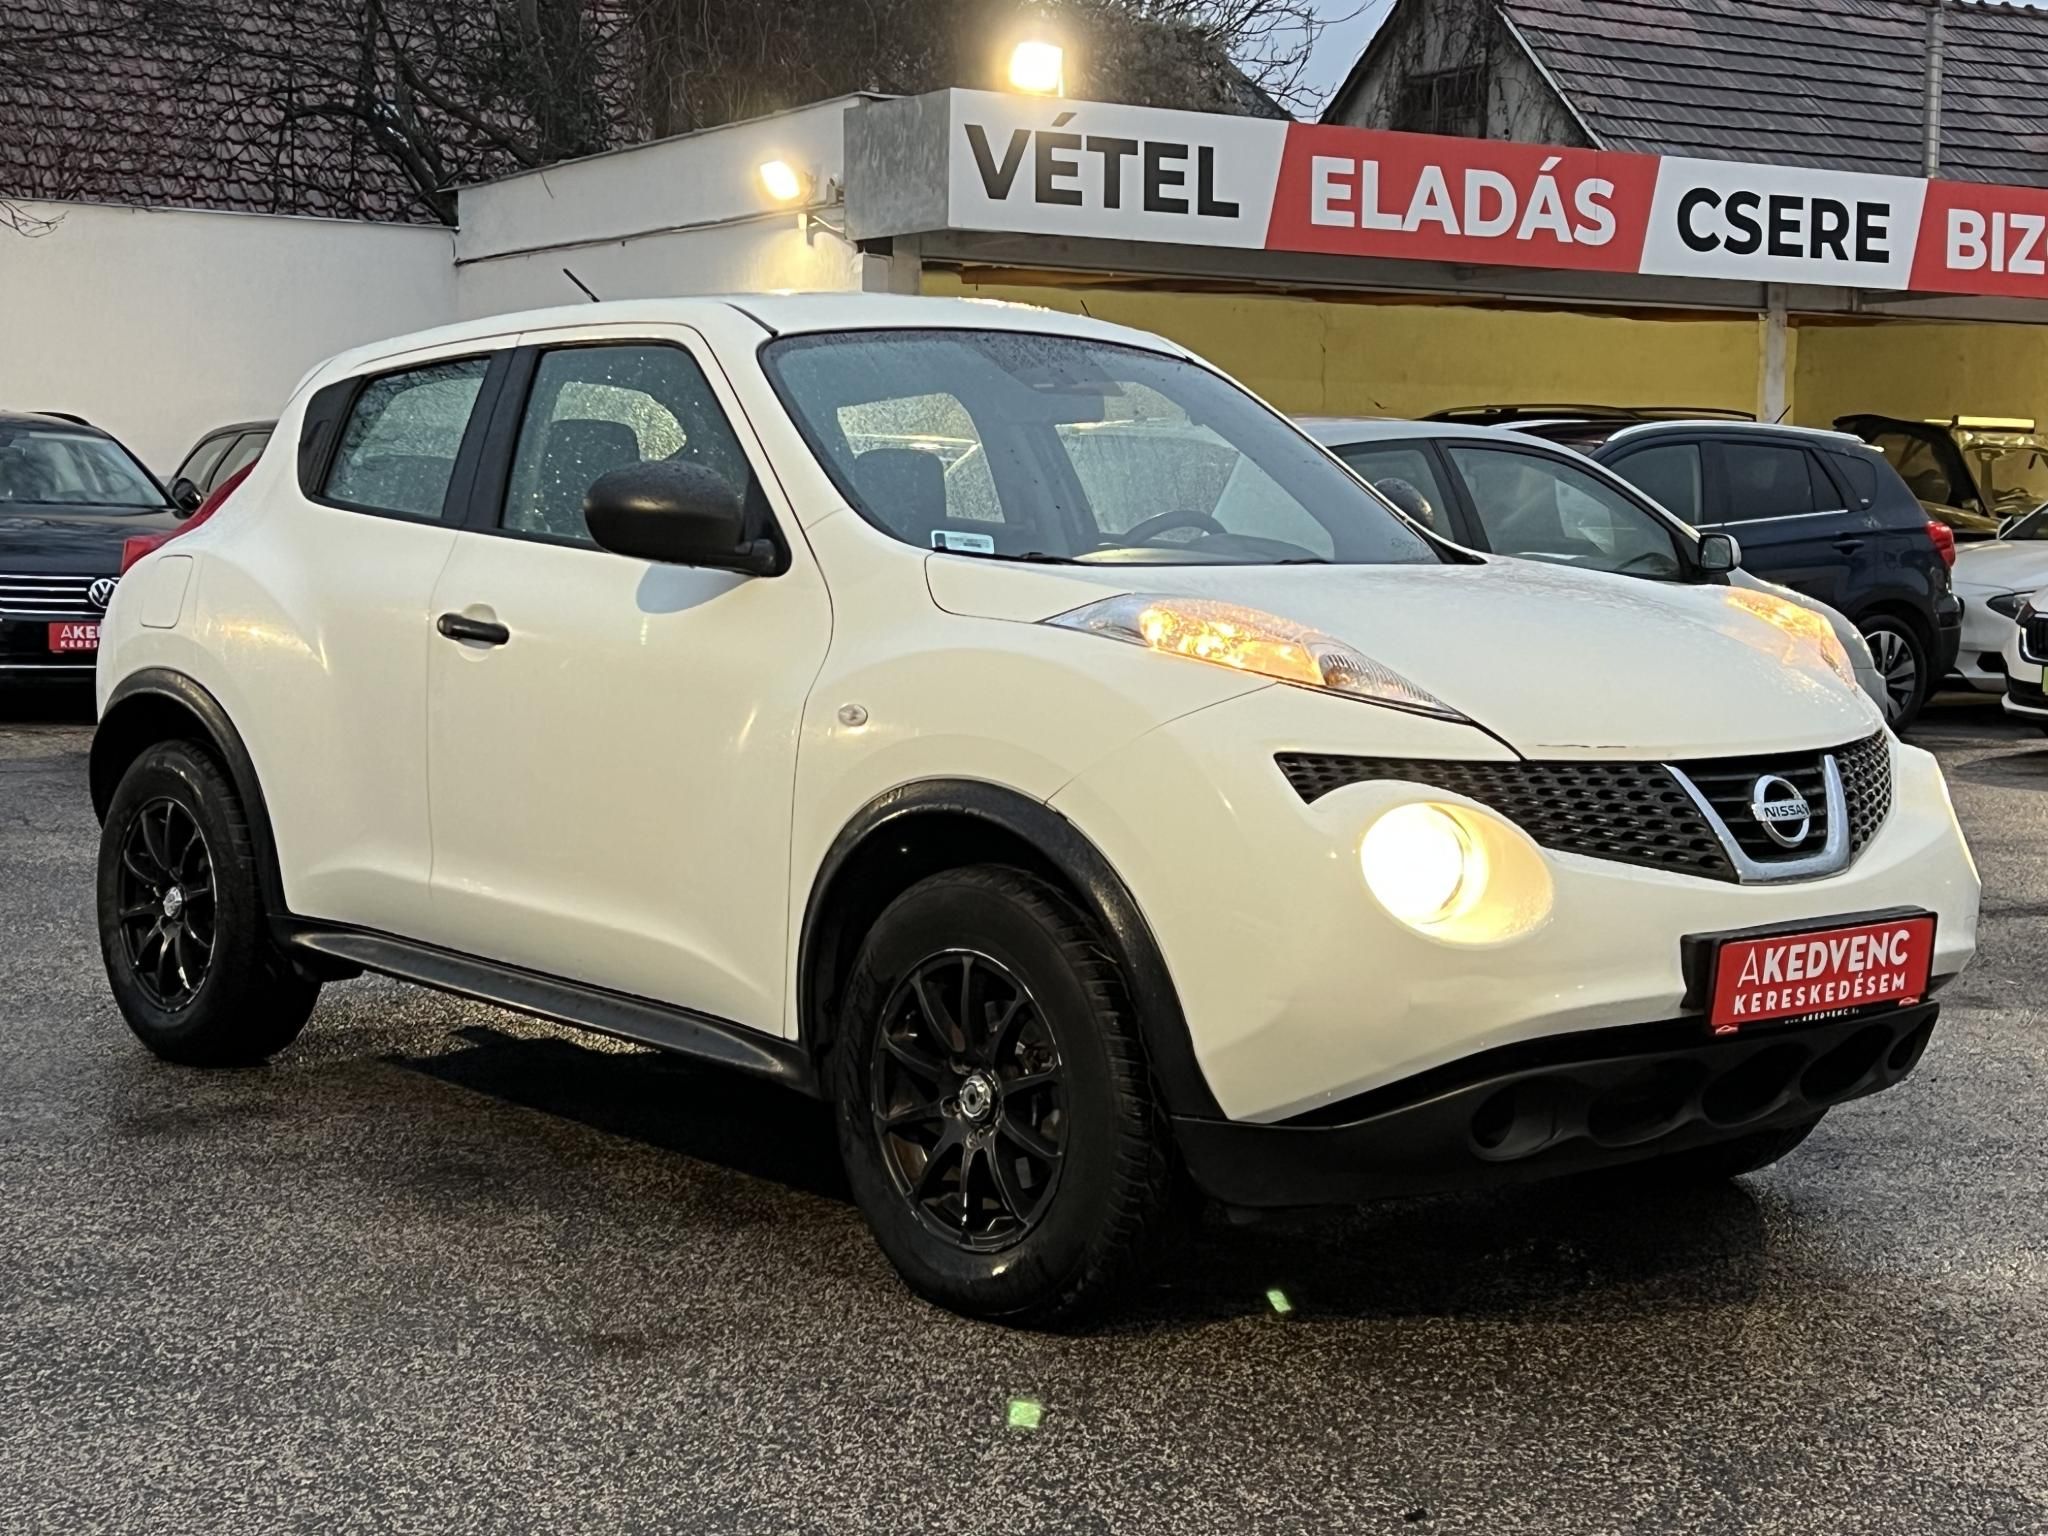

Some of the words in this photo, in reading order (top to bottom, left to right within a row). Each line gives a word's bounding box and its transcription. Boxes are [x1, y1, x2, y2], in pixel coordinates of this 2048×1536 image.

[964, 112, 1240, 219] VÉTEL
[1311, 156, 1617, 247] ELADÁS
[1677, 187, 1891, 264] CSERE
[1946, 208, 2048, 275] BIZ
[1763, 803, 1810, 818] NISSAN
[1733, 970, 1907, 1016] KERESKEDÉSEM
